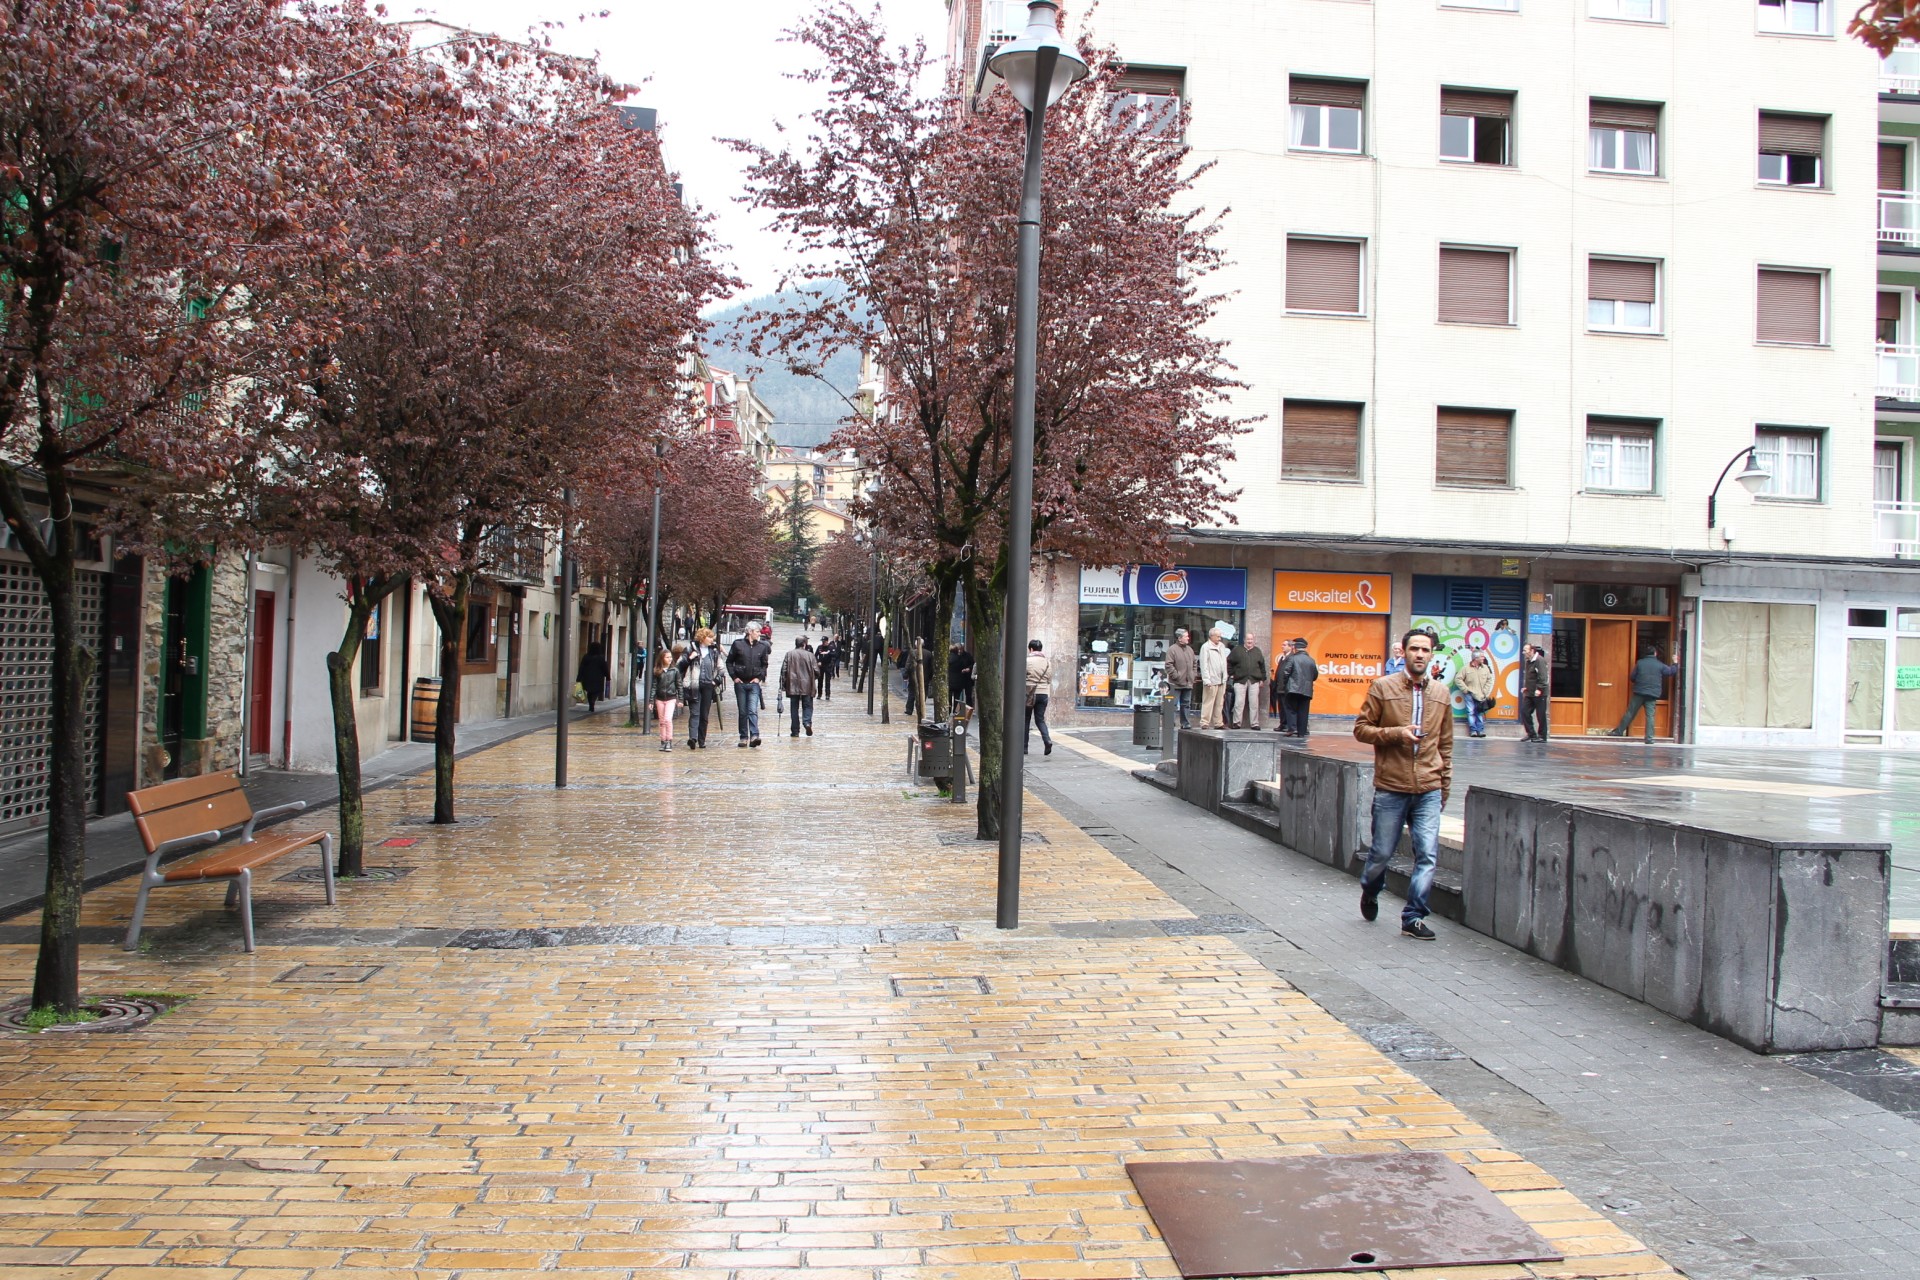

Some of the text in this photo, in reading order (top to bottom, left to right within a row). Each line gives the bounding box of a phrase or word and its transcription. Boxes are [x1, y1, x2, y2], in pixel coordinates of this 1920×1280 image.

[1160, 581, 1183, 589] IKATZ
[1084, 586, 1119, 594] FUJIFILM
[1288, 589, 1351, 603] euskaltel
[1607, 596, 1613, 604] 2
[1317, 661, 1382, 676] skaltel
